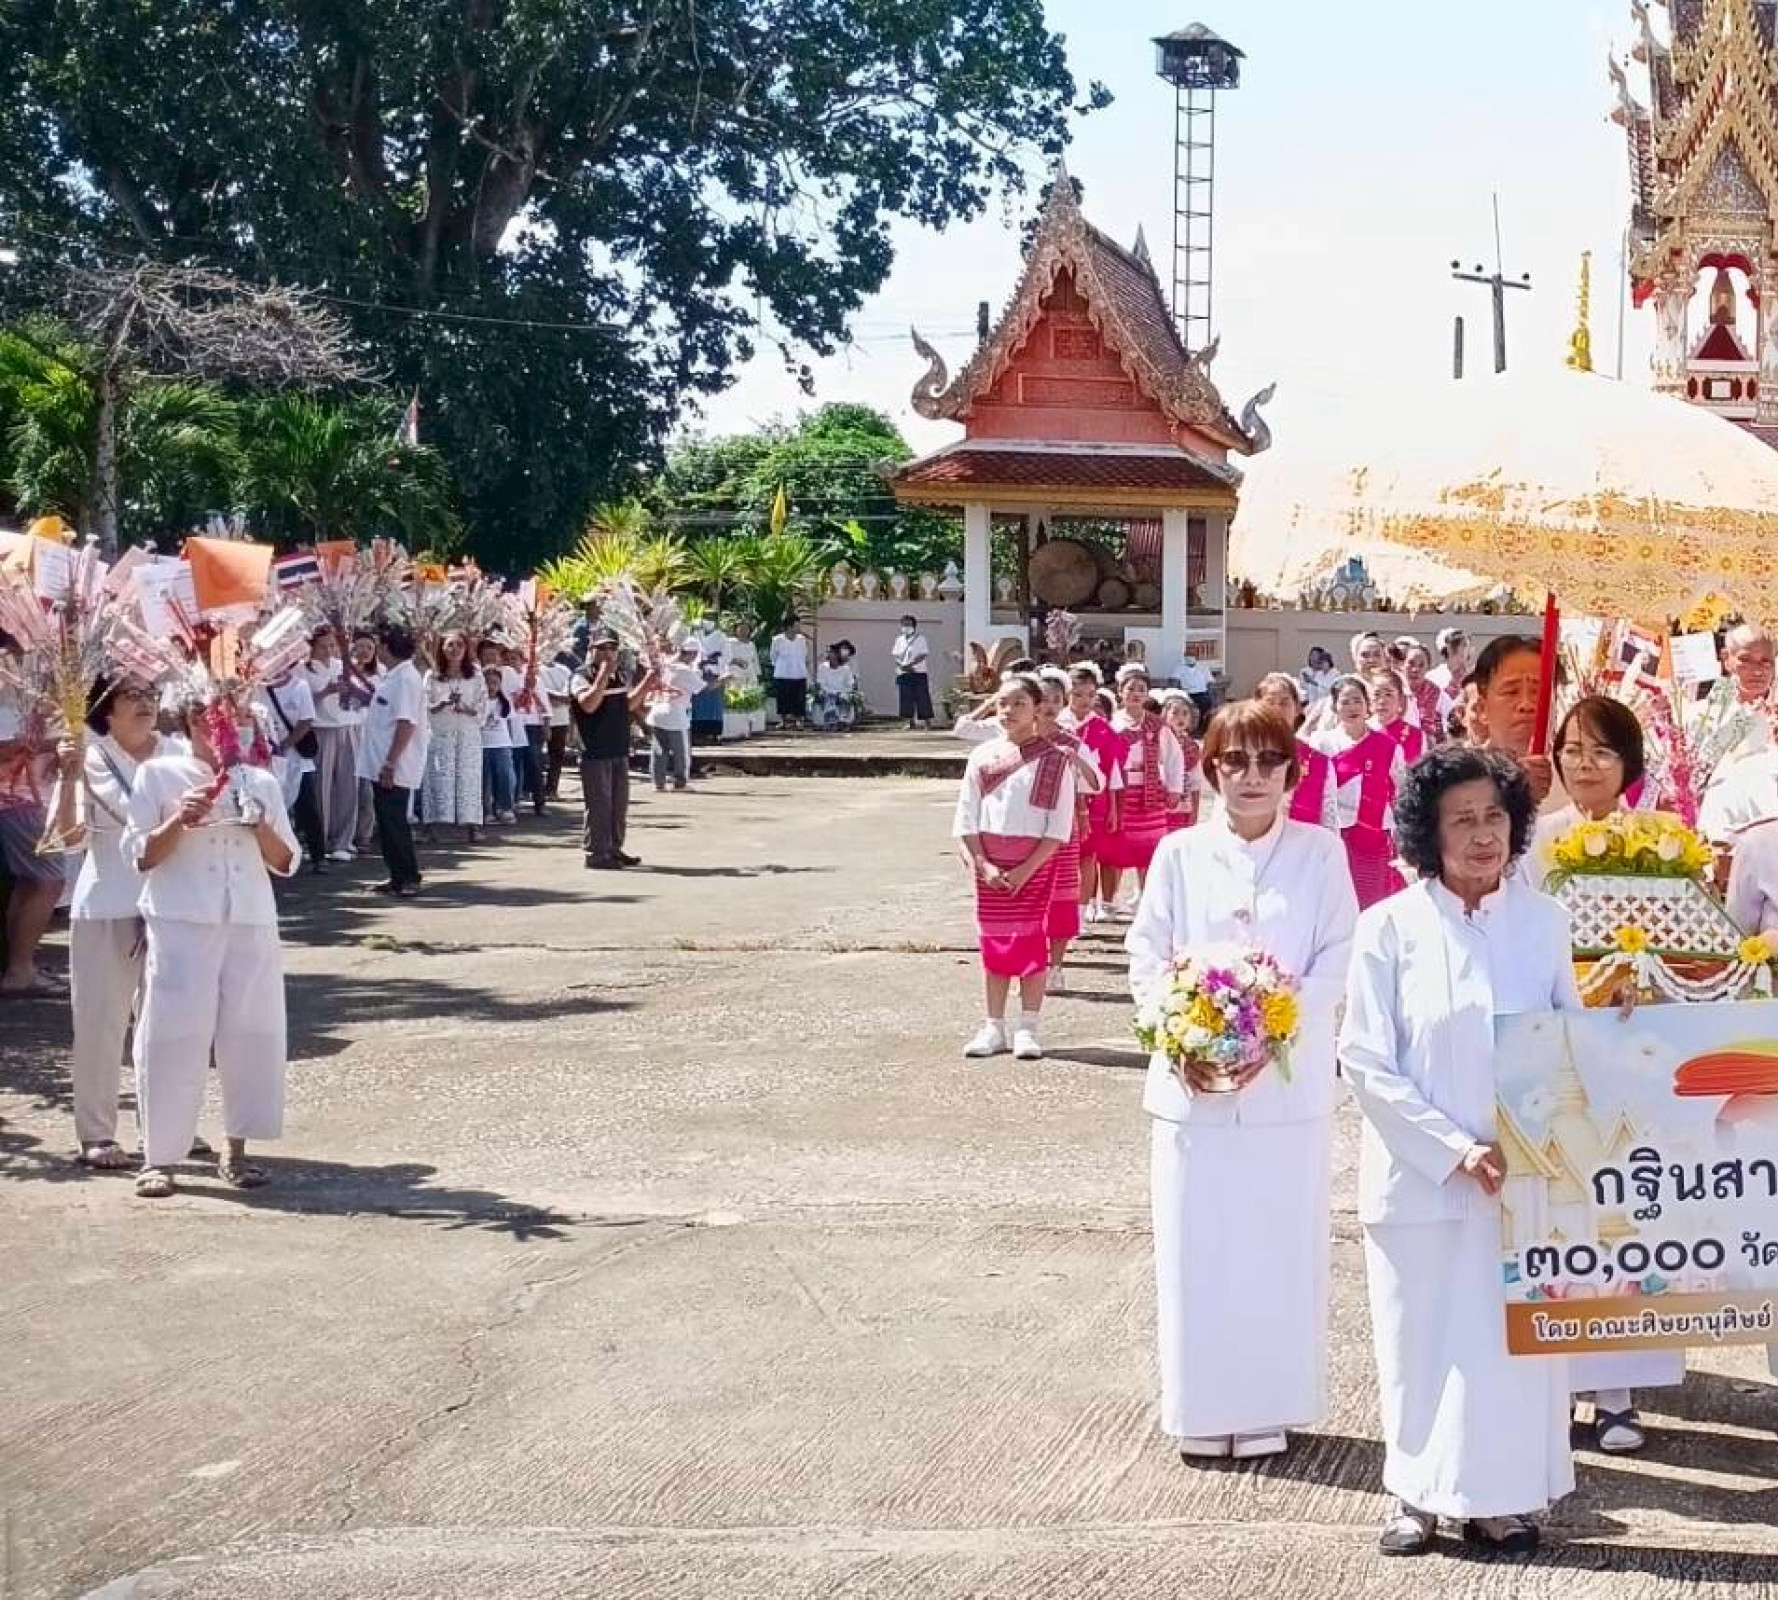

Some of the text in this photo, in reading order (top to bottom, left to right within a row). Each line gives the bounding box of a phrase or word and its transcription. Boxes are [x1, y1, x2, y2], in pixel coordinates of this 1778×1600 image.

[1526, 1238, 1725, 1283] ๓๐,๐๐๐
[1533, 1314, 1578, 1338] โดย
[1589, 1303, 1772, 1338] คณะศิษยานุศิษย์
